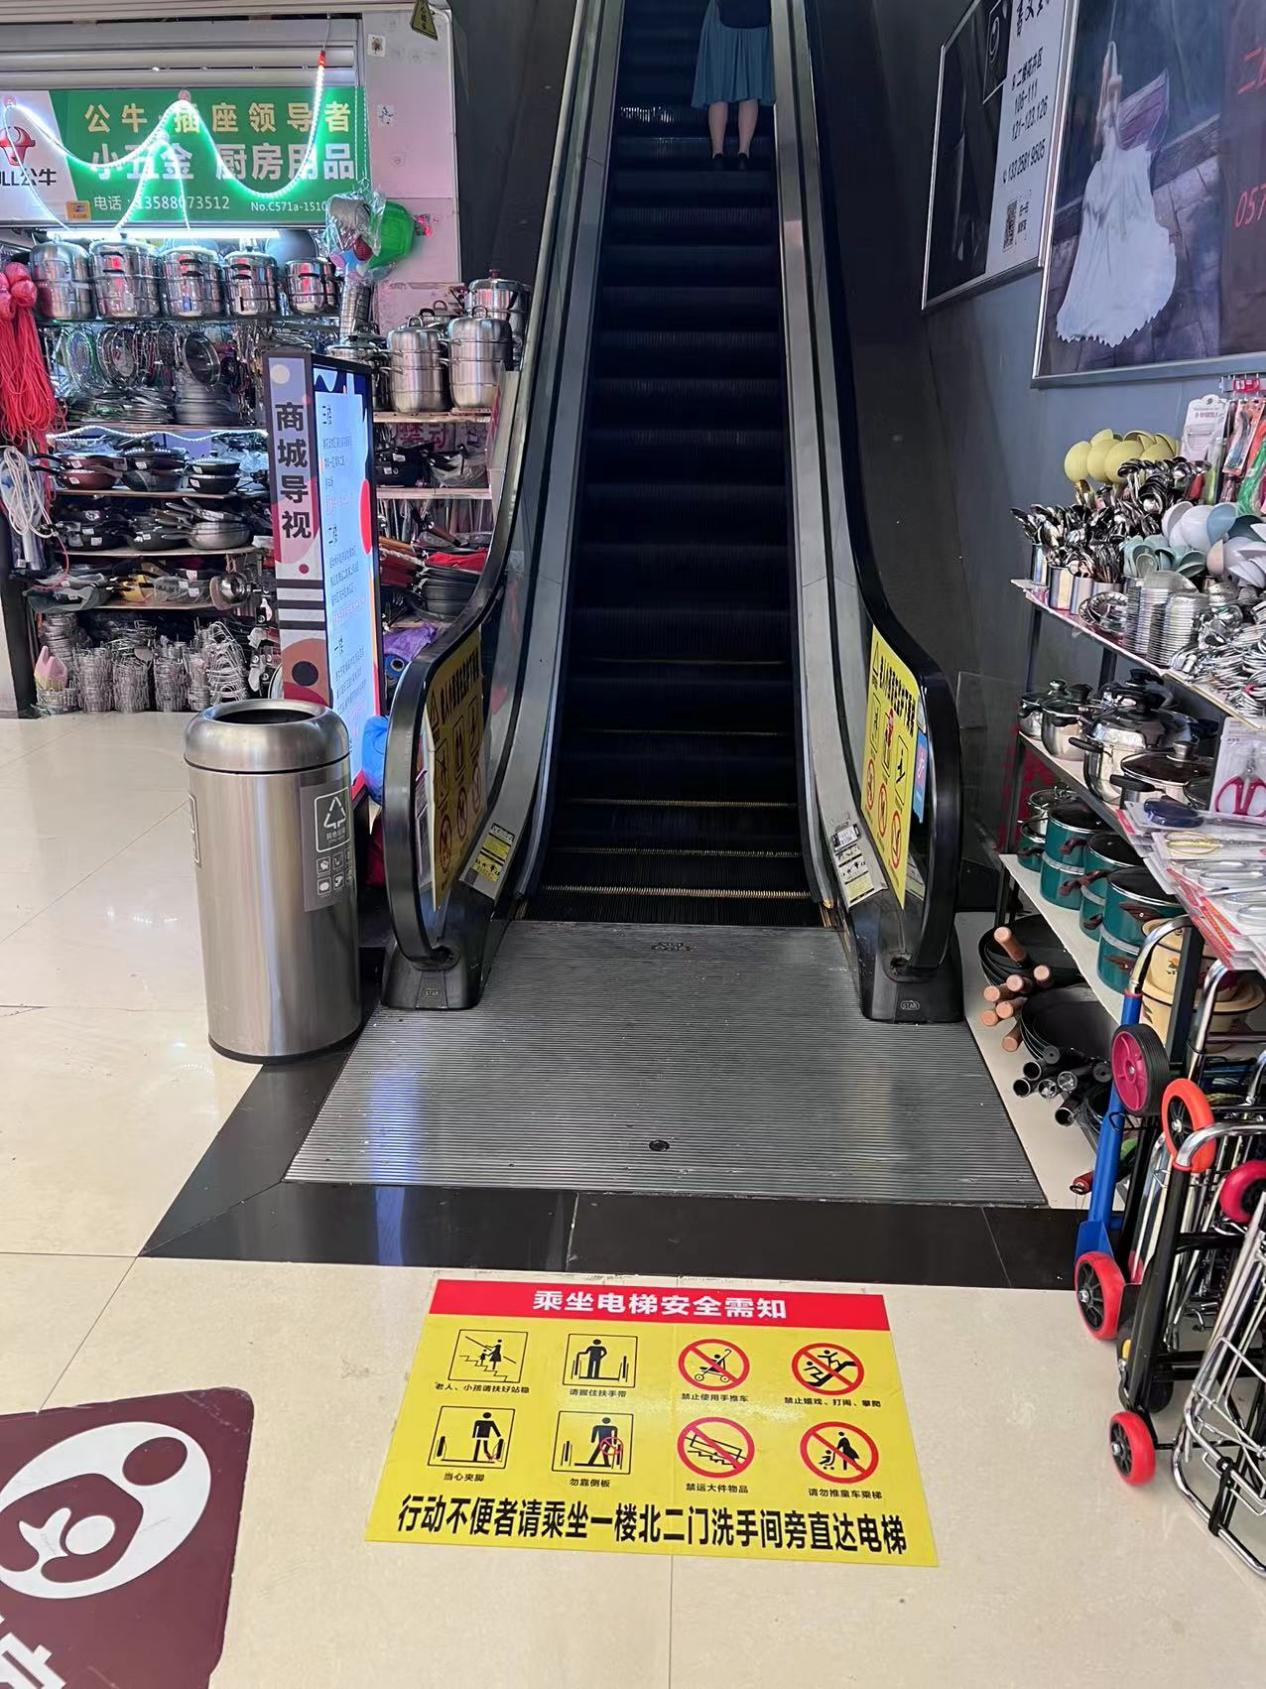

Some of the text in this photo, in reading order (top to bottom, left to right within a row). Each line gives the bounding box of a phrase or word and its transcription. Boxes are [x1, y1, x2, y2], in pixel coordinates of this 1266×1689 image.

[0, 168, 56, 186] LL公牛
[93, 142, 354, 180] 小五金 厨房用品
[275, 402, 311, 538] 商城导视
[532, 1290, 787, 1319] 乘坐电梯安全需知
[397, 1493, 908, 1555] 行动不便者请乘坐一楼北二门洗手间旁直达电梯
